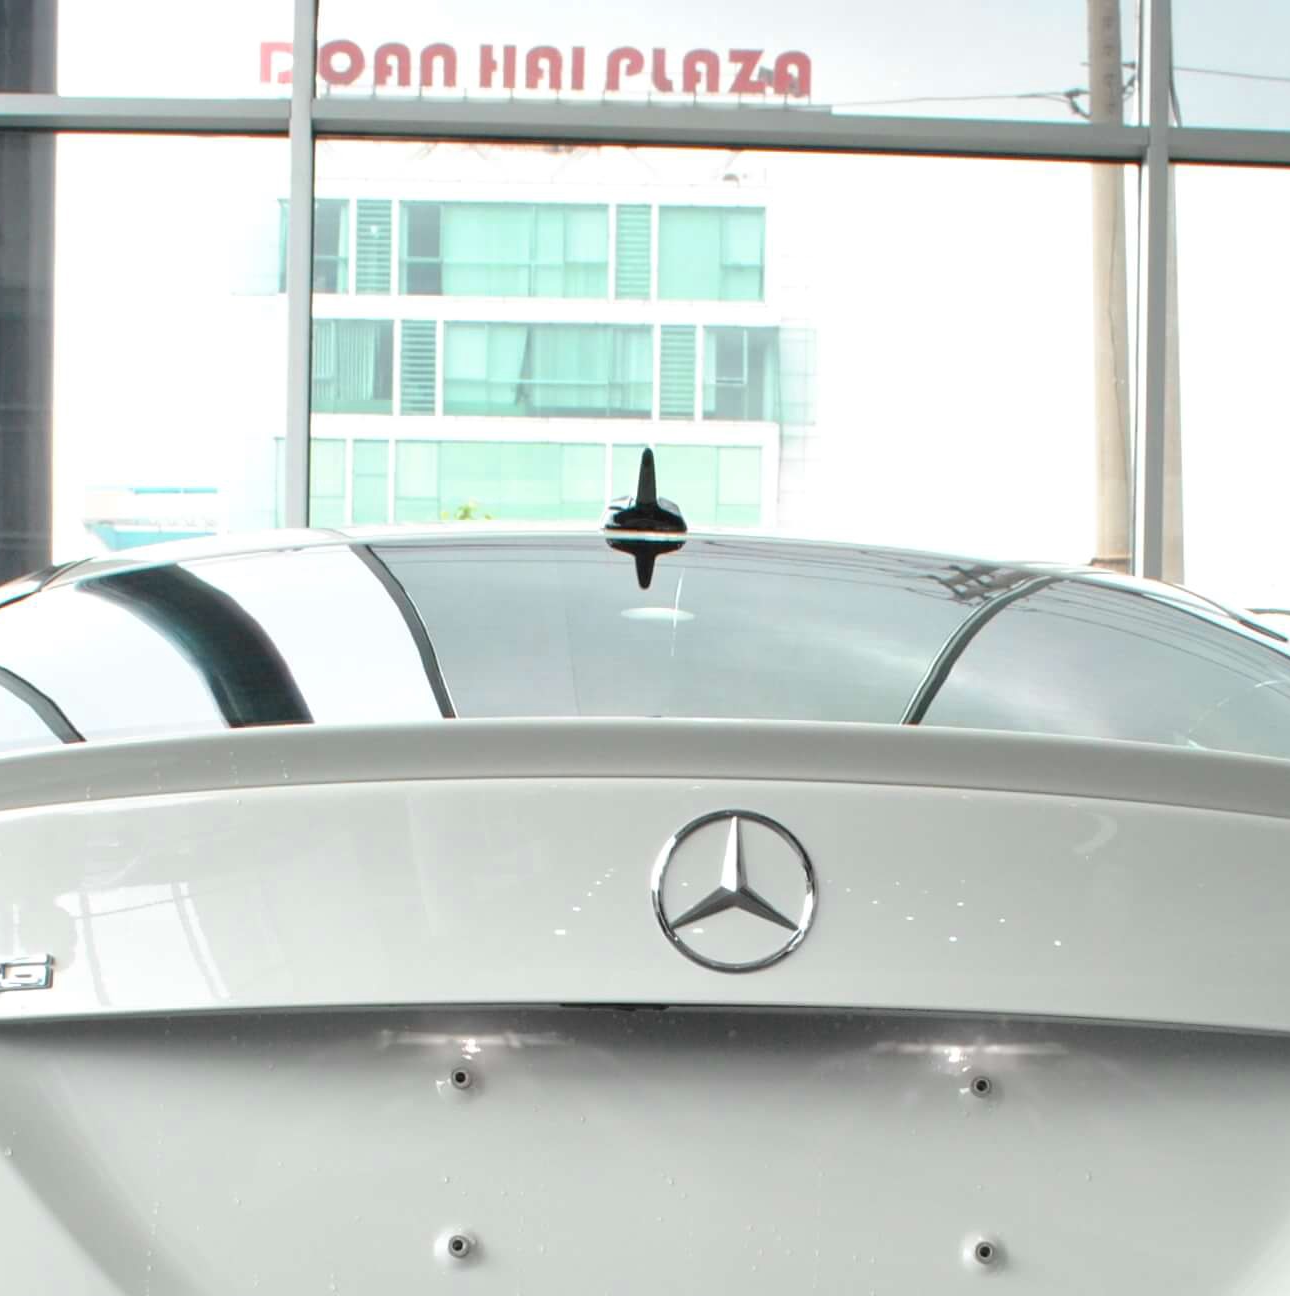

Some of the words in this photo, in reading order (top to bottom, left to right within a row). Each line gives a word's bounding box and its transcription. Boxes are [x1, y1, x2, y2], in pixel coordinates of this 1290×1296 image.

[260, 39, 458, 87] DOAN
[479, 44, 586, 90] HAI
[605, 47, 812, 97] PLAZA
